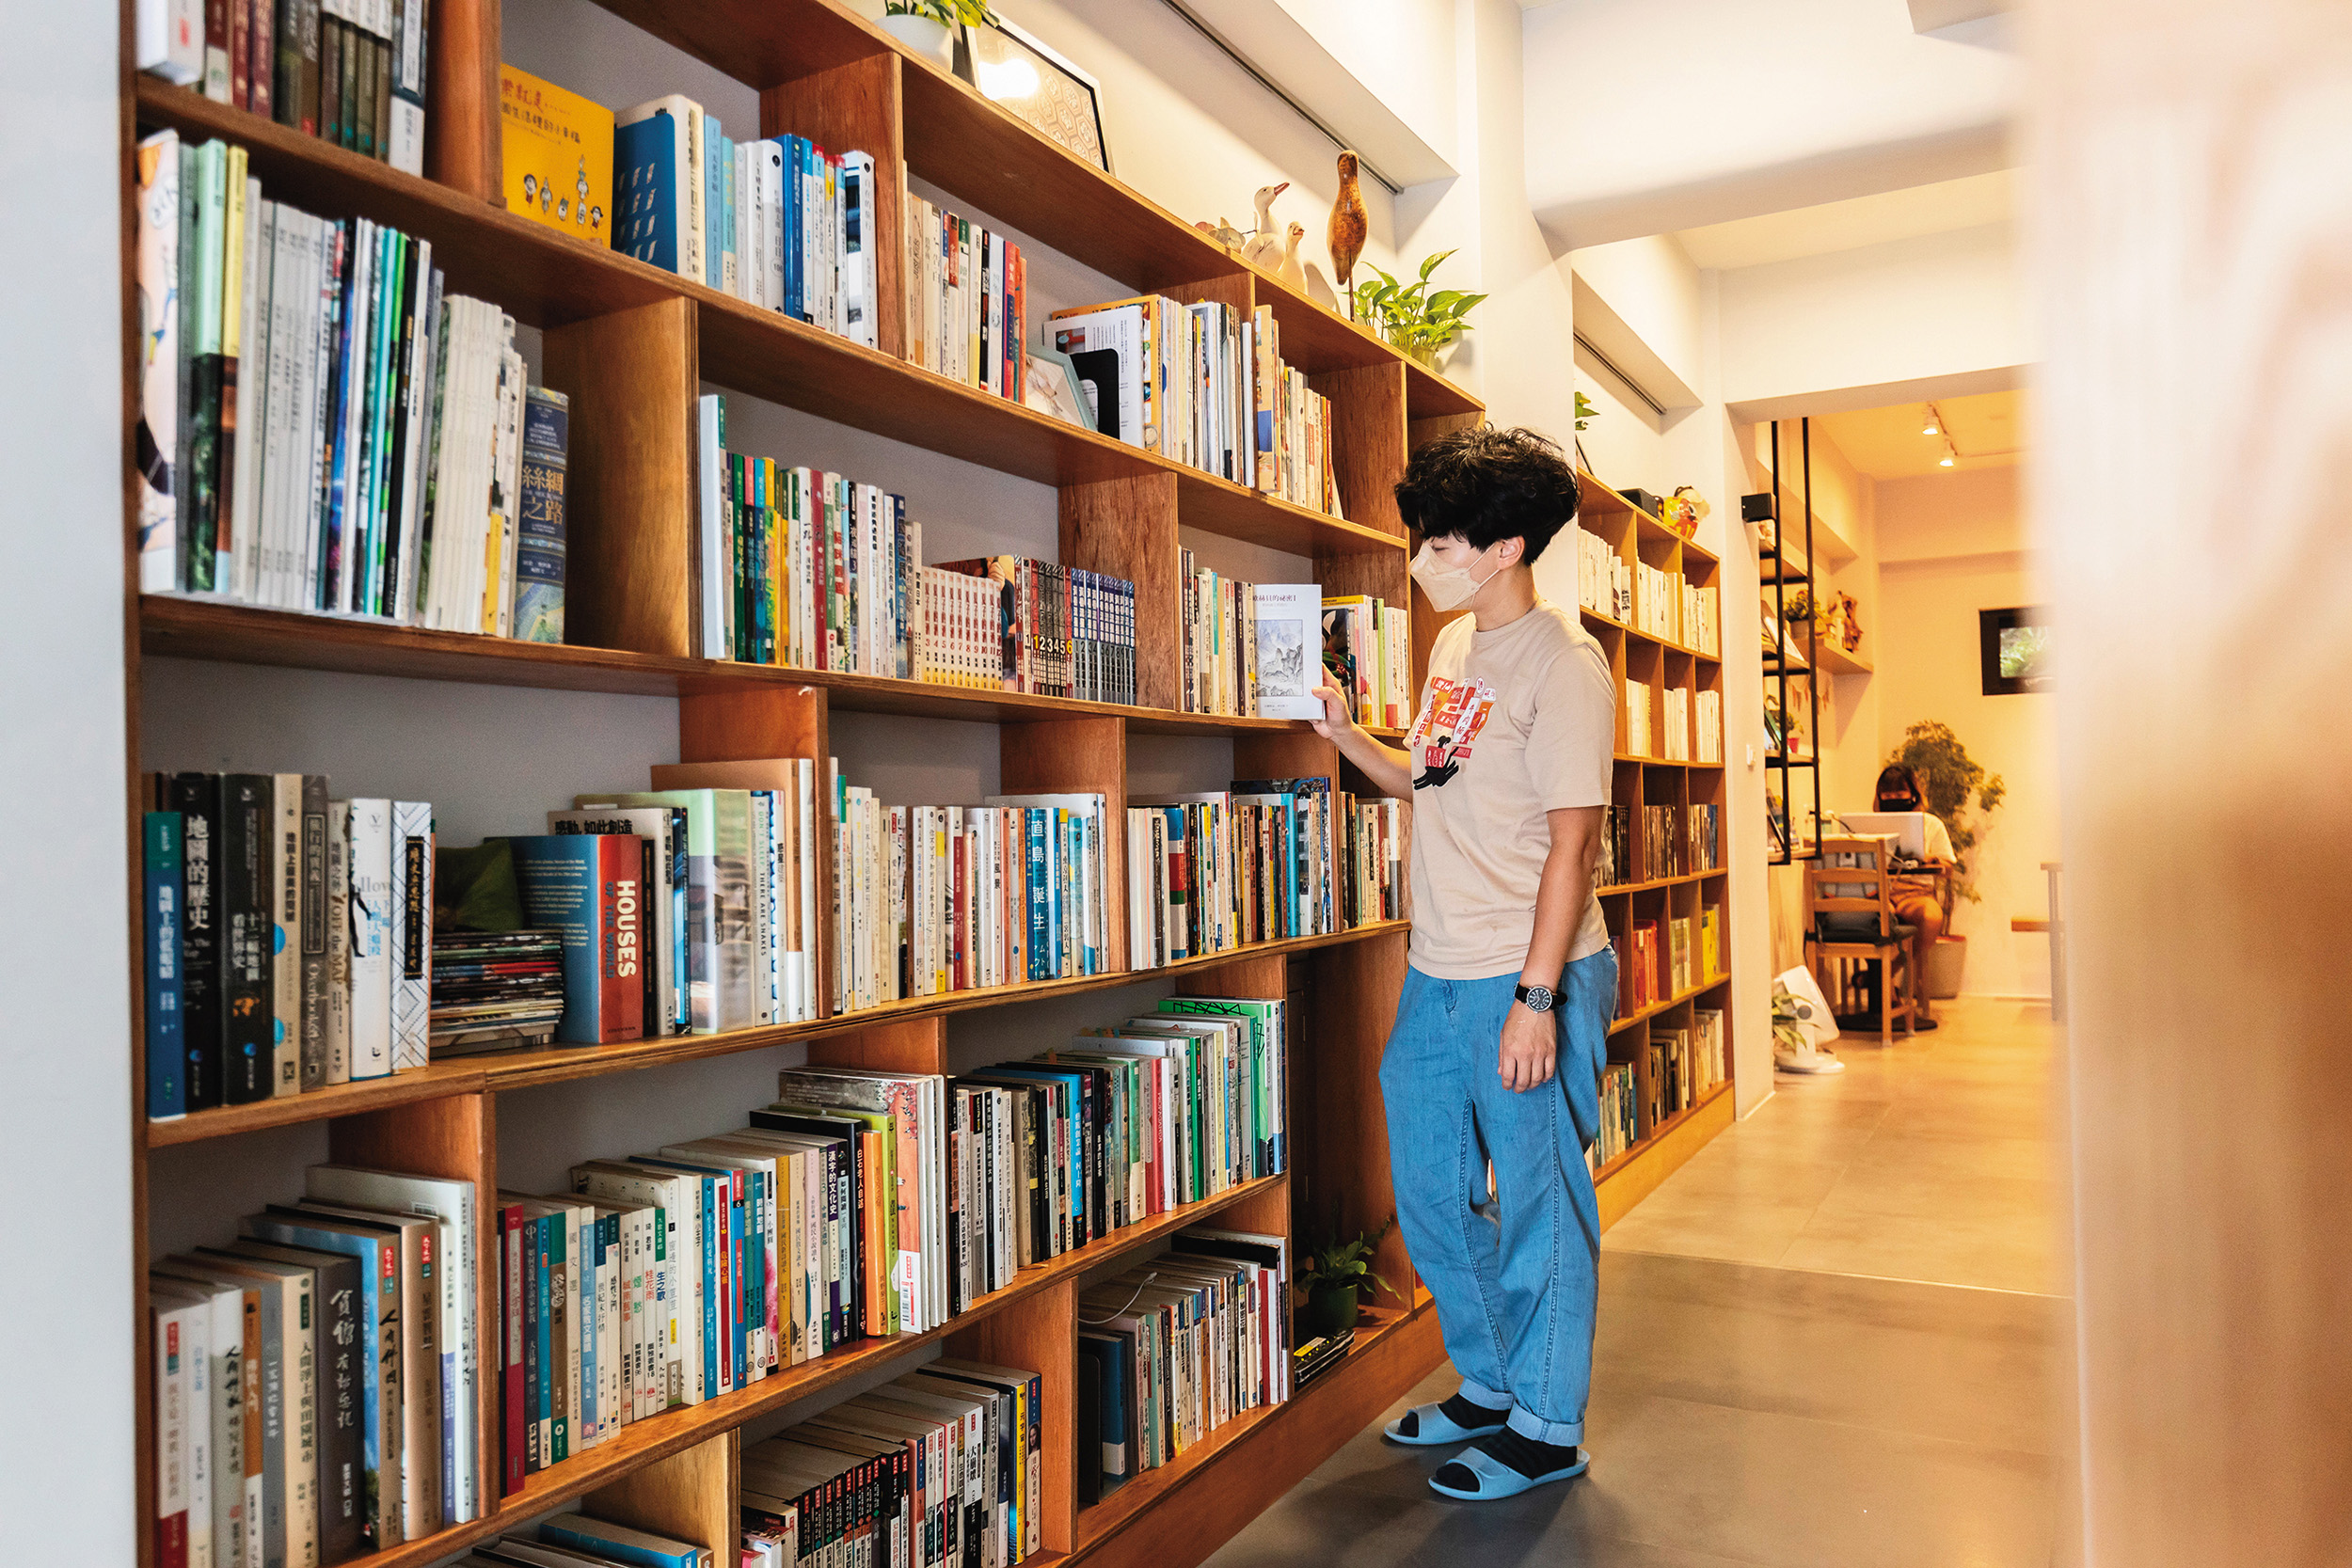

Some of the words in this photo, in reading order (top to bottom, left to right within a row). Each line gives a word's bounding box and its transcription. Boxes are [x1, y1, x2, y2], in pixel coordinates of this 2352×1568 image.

[522, 466, 564, 496] 絲綢
[521, 495, 564, 525] 之路
[925, 639, 930, 647] 3
[933, 640, 939, 648] 4
[941, 641, 946, 649] 5
[949, 641, 955, 650] 6
[958, 641, 962, 651] 7
[965, 644, 971, 653] 8
[974, 645, 978, 654] 9
[980, 646, 987, 655] 10
[990, 647, 995, 656] 11
[186, 814, 211, 932] 地圖的歷史
[1031, 820, 1045, 930] 直島誕生
[605, 881, 614, 899] OF
[605, 904, 614, 928] THE
[616, 879, 637, 978] HOUSES
[605, 931, 614, 979] WORLD
[828, 1149, 838, 1216] 漢字的文化史
[645, 1269, 655, 1302] 桂花雨
[656, 1272, 666, 1302] 生之歌
